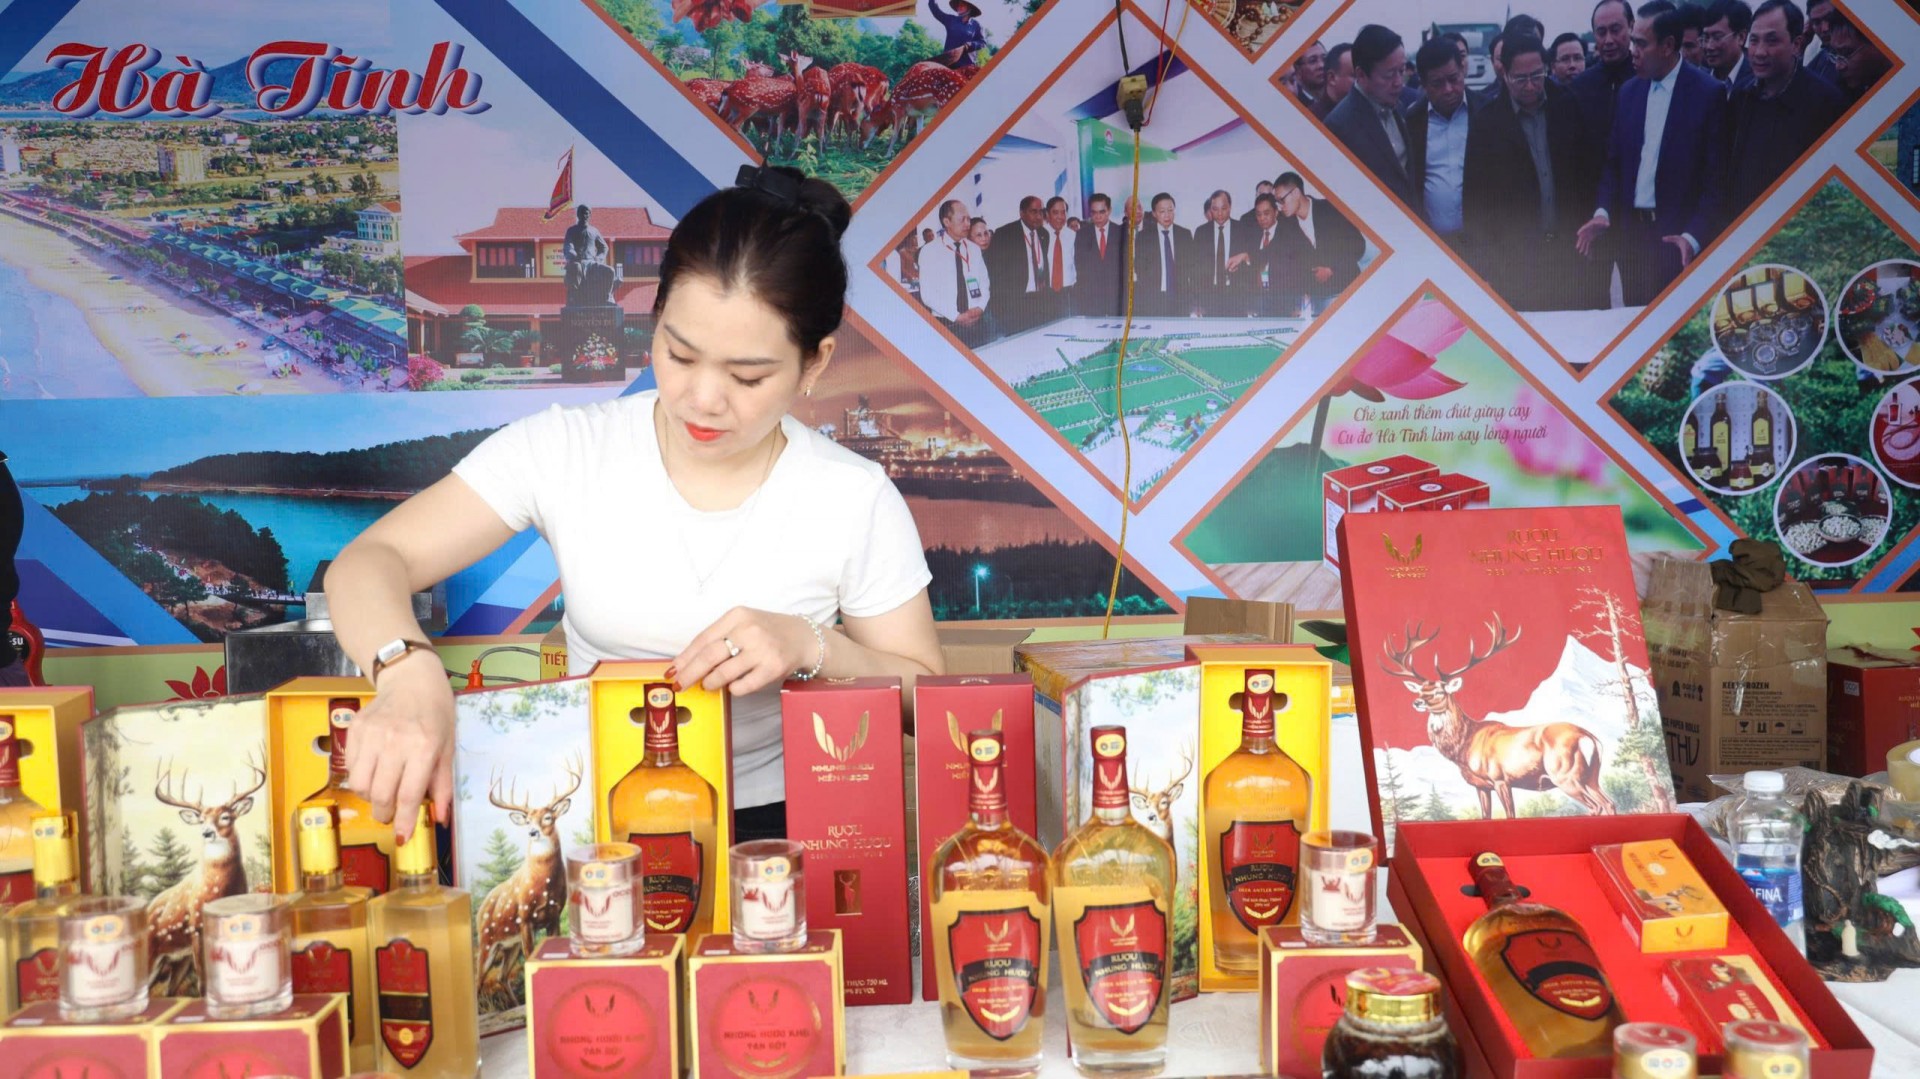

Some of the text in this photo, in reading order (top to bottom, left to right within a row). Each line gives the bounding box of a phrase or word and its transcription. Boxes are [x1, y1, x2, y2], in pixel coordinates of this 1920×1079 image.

[45, 40, 490, 118] Hà Tĩnh
[1379, 404, 1410, 420] xanh
[1413, 404, 1442, 420] thêm
[1446, 403, 1471, 419] chút
[1473, 406, 1504, 422] gừng
[1508, 406, 1530, 421] cay
[1337, 424, 1548, 445] Cu đơ Hà Tĩnh làm say lòng người
[543, 651, 568, 667] TIẾT
[1722, 681, 1770, 689] KEE ROZEN
[800, 839, 849, 852] NHUNG
